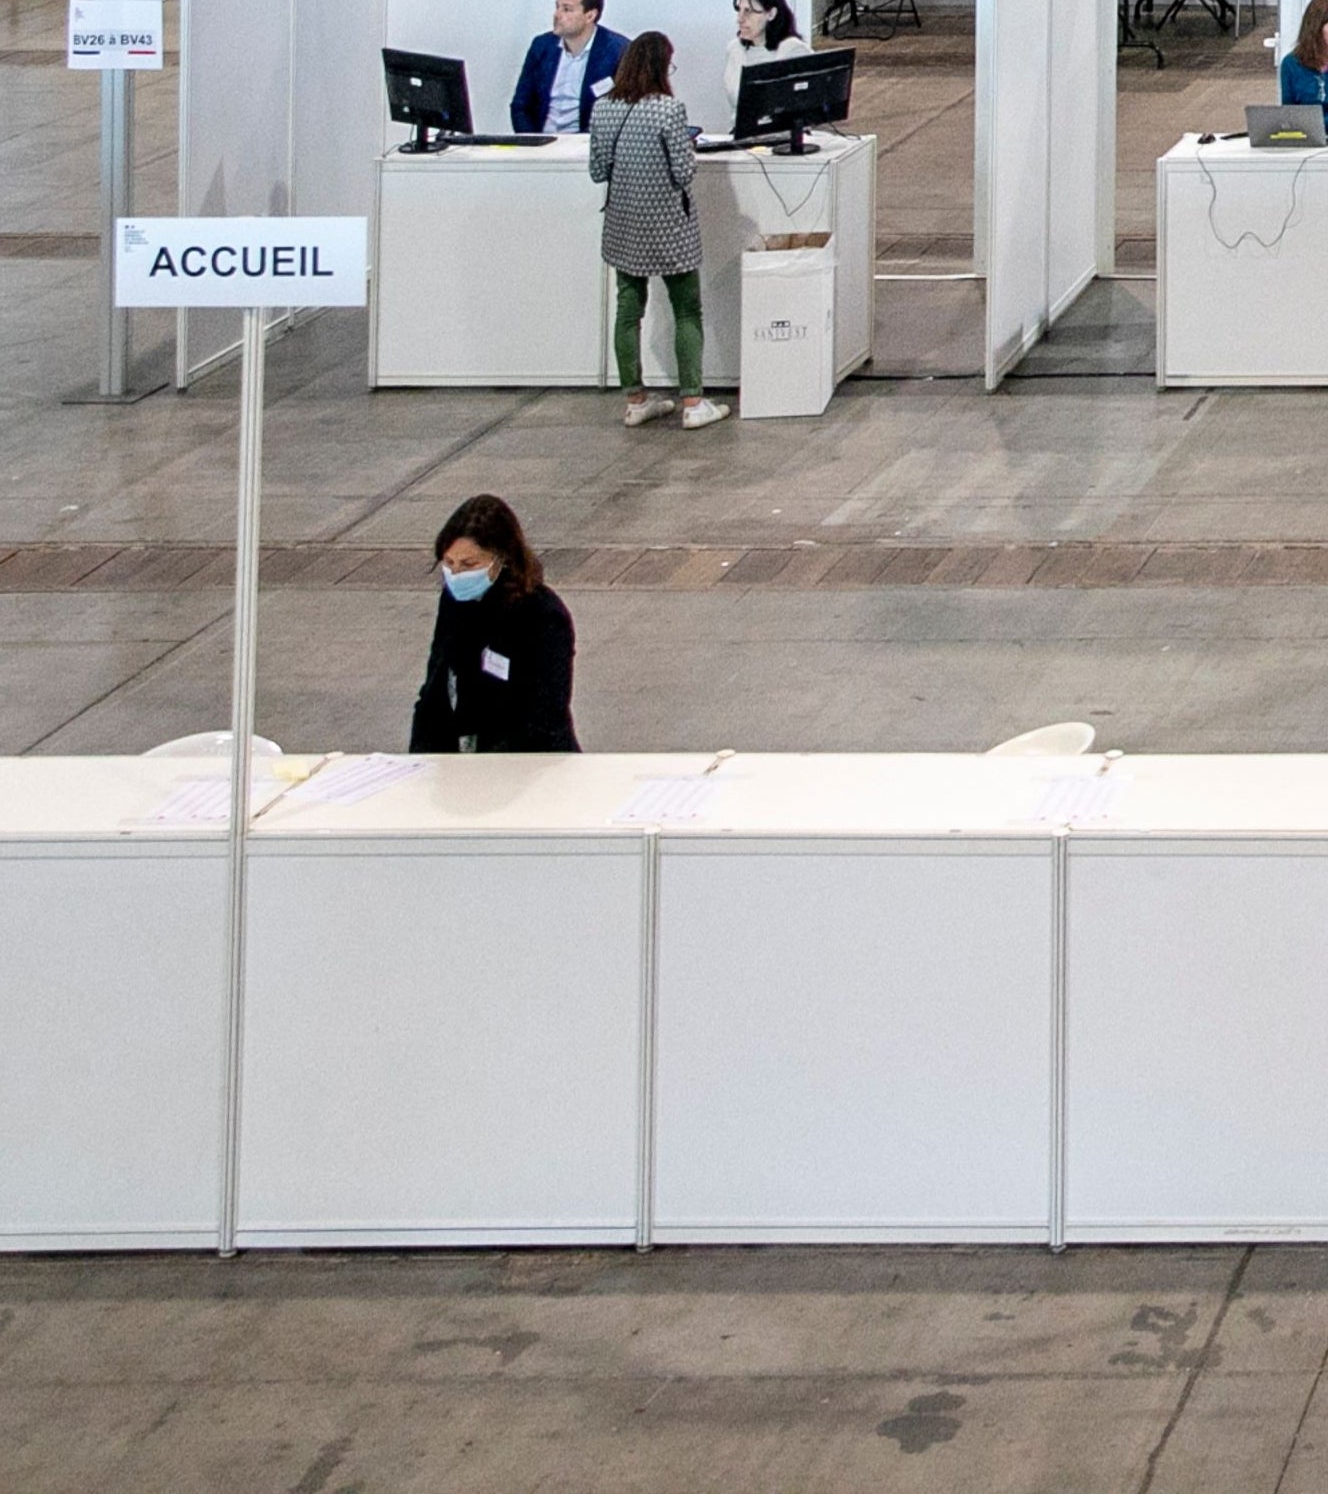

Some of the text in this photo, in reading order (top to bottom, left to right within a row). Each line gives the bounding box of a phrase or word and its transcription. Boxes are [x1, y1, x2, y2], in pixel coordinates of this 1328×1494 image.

[73, 34, 106, 46] BV26
[120, 33, 153, 46] BV43
[149, 245, 335, 278] ACCUEIL
